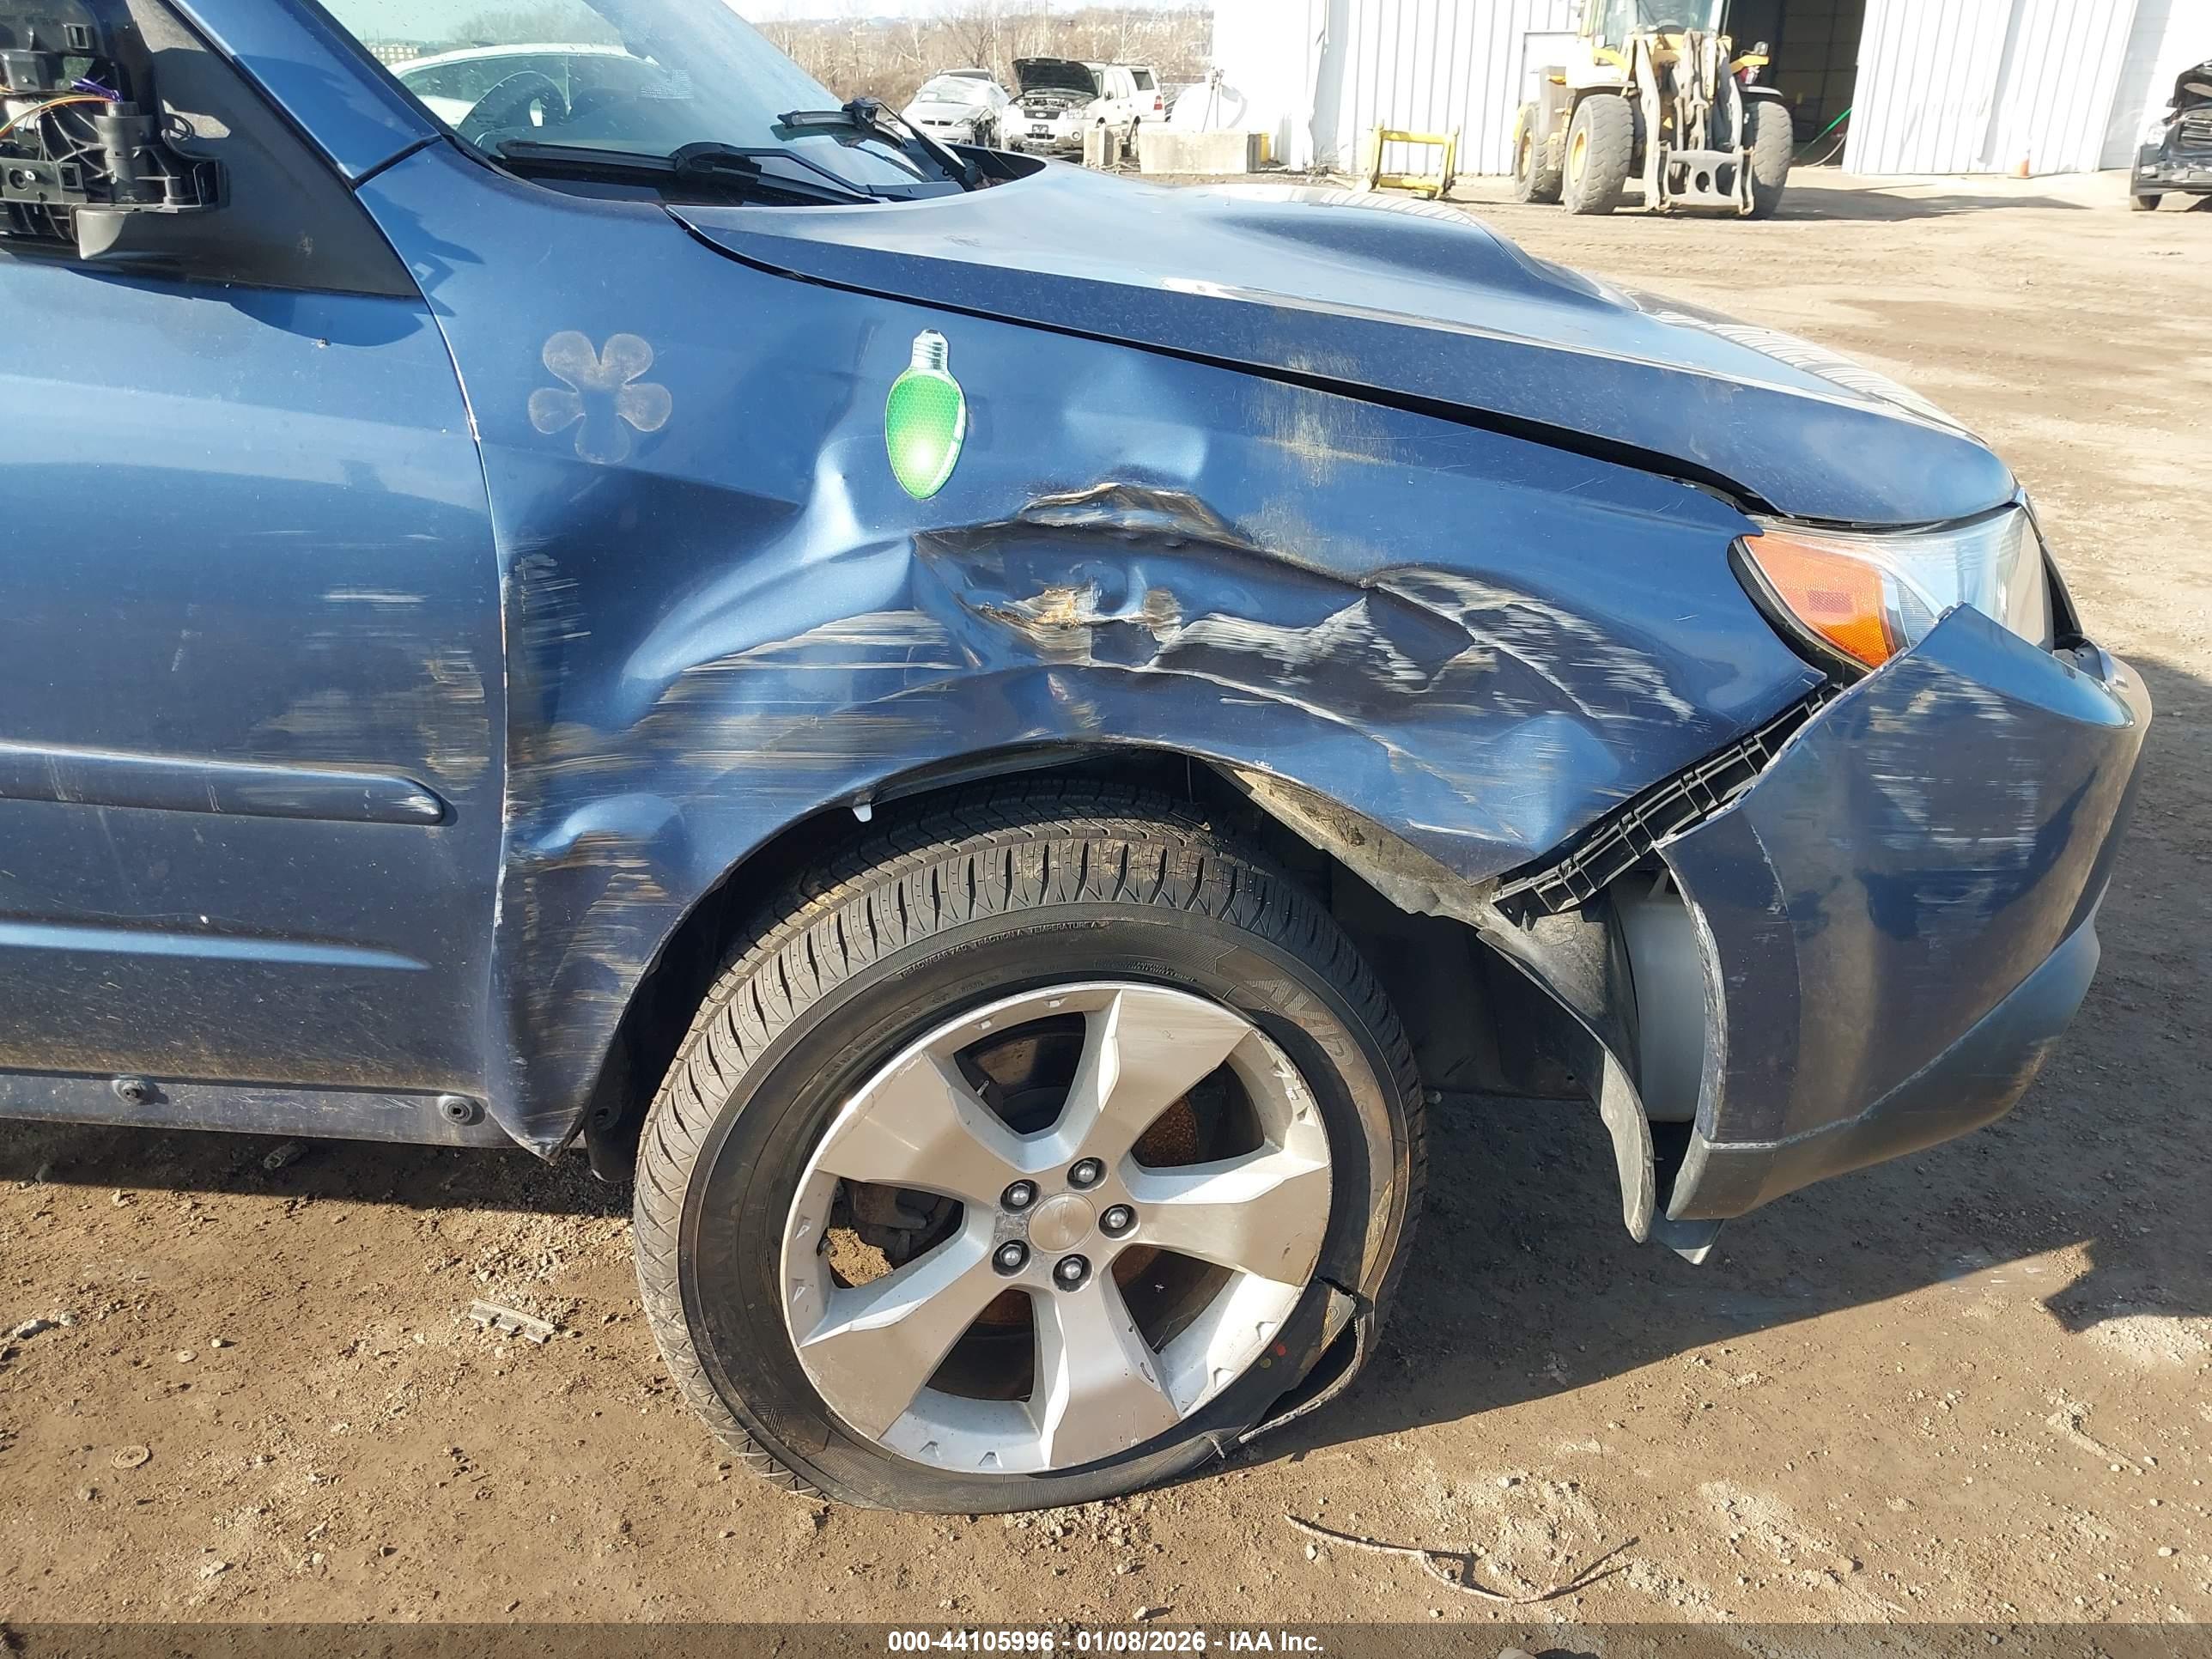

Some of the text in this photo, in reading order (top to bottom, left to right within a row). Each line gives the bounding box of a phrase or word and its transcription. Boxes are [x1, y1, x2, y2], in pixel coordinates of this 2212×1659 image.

[896, 951, 949, 978] TREADWEAR
[950, 945, 969, 956] 740
[973, 931, 1015, 948] TRACTION
[1030, 921, 1089, 934] TEMPERATURE
